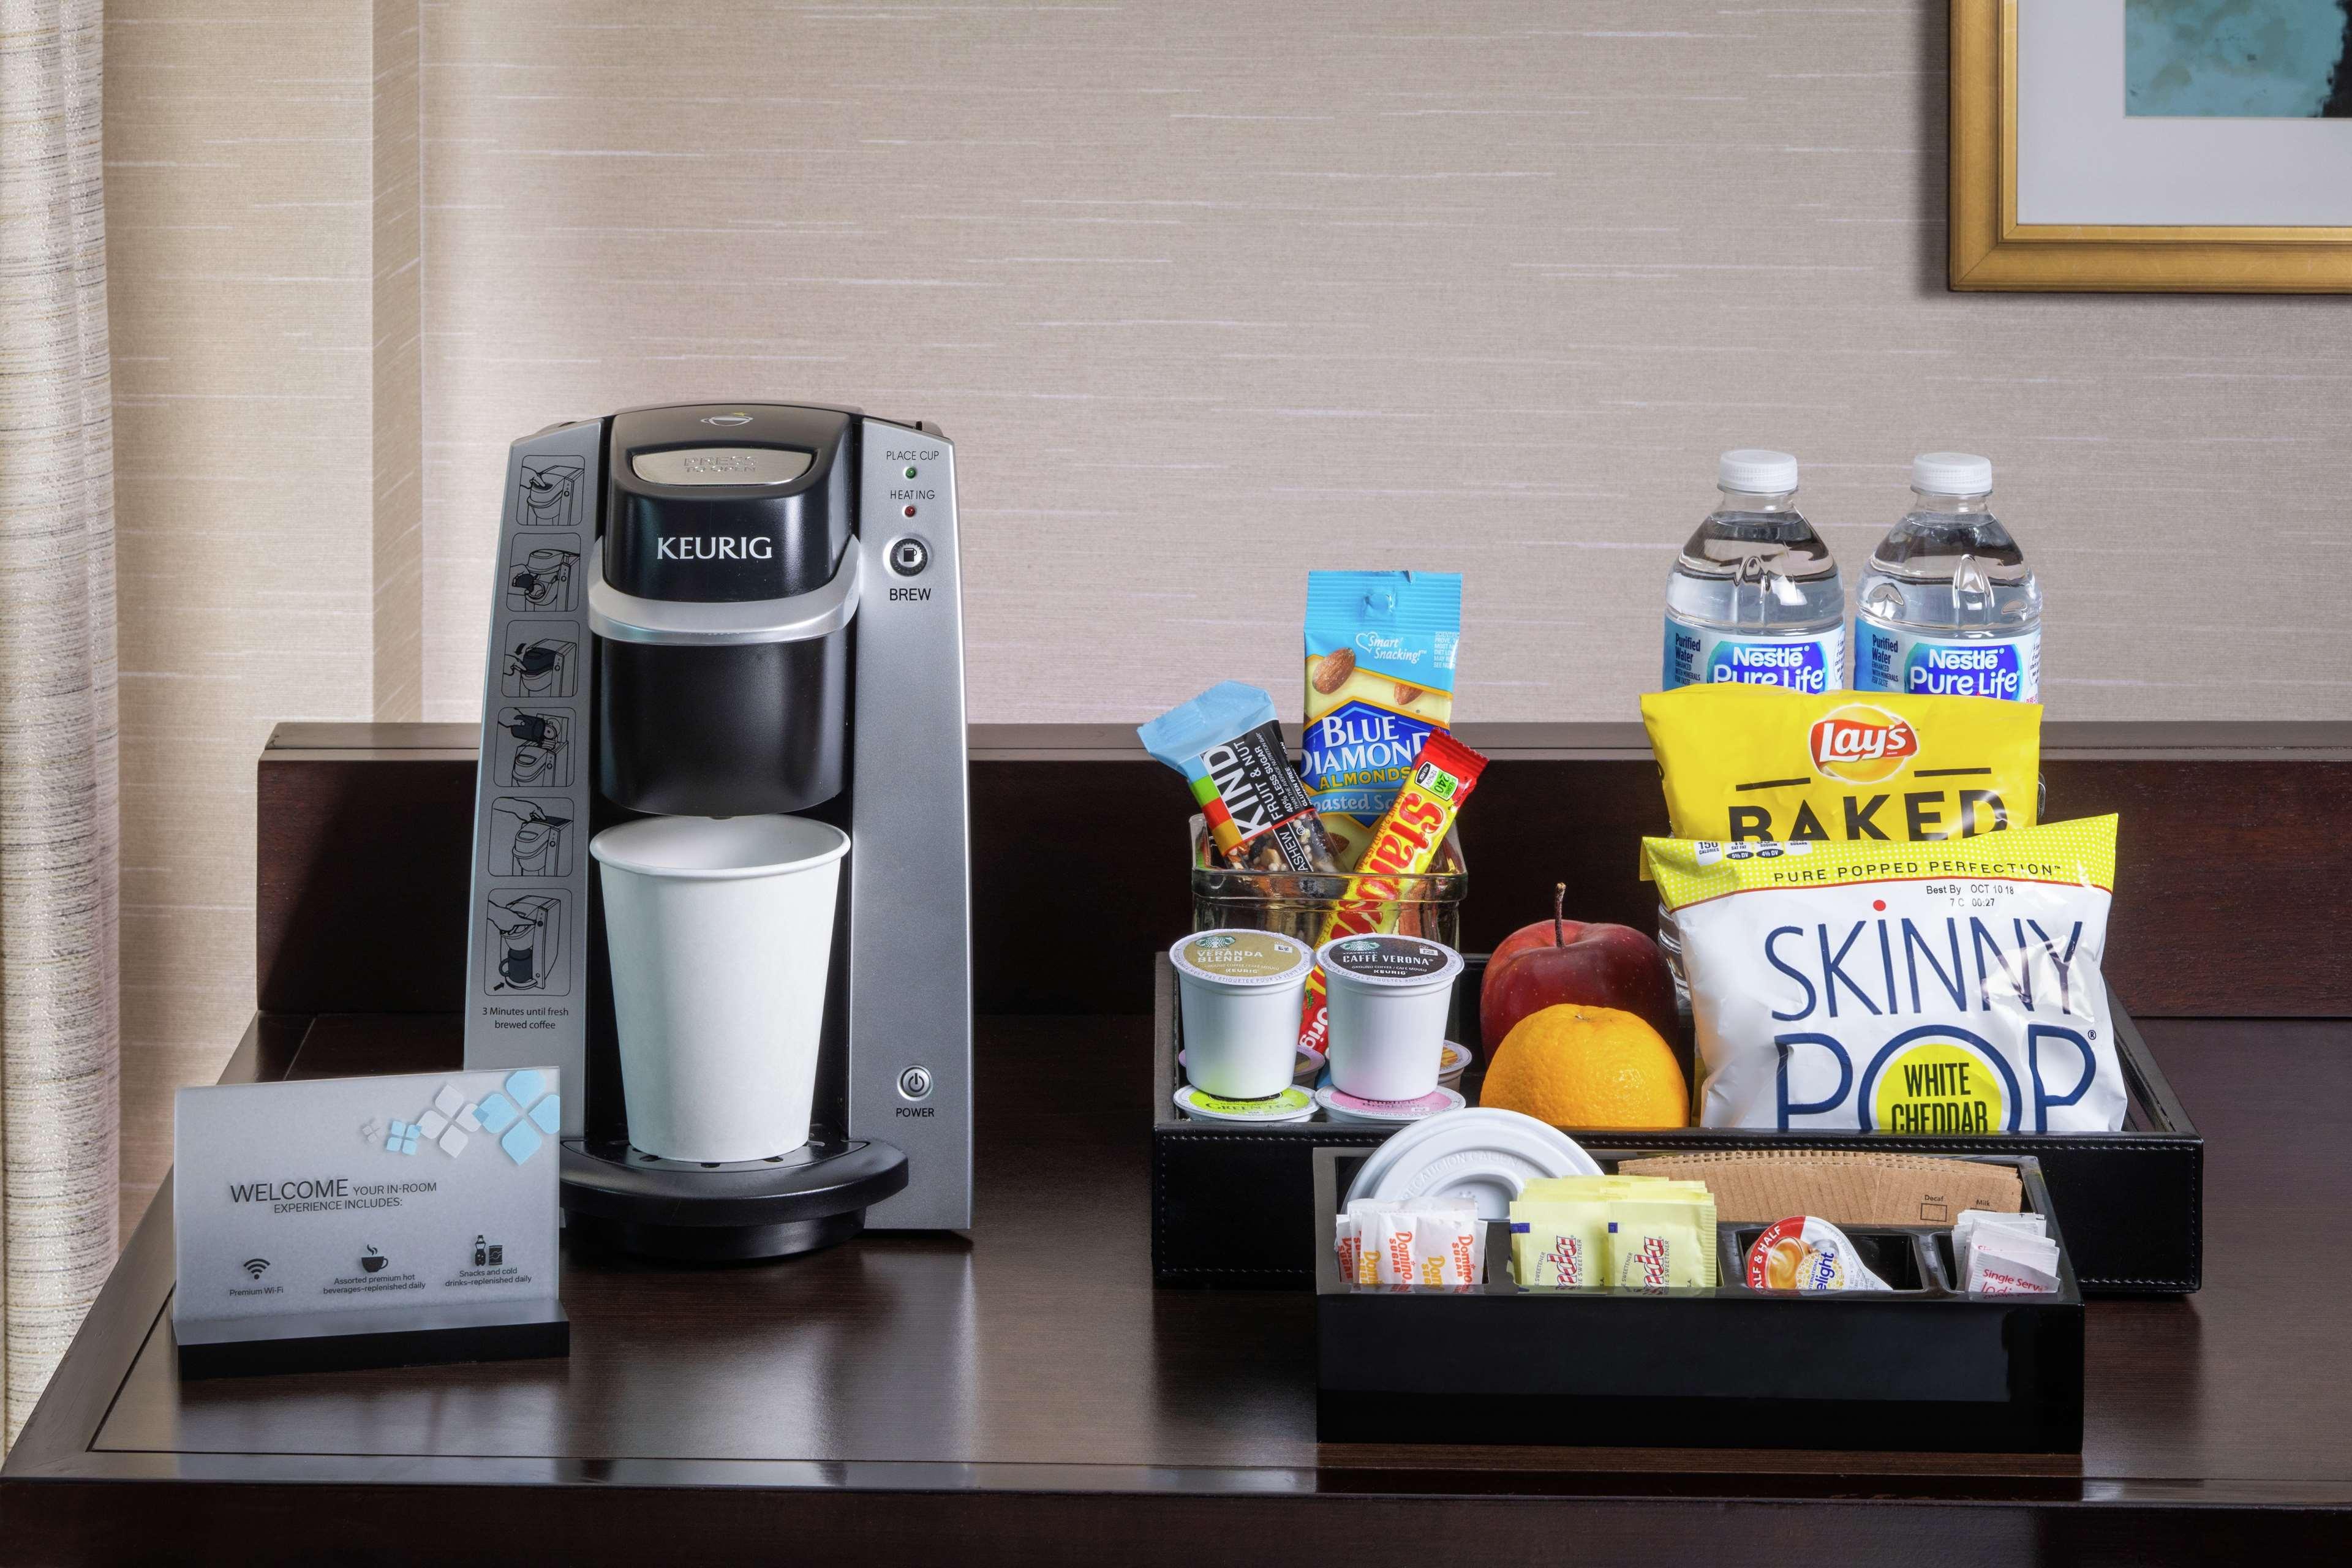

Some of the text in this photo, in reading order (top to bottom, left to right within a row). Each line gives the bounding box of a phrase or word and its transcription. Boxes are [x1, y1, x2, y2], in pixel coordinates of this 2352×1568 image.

[886, 451, 940, 460] PLACE CUP
[890, 490, 936, 500] HEATING
[657, 537, 773, 560] KEURIG
[889, 588, 932, 601] BREW
[1368, 636, 1400, 647] Smart
[1675, 633, 1701, 652] Purified
[1872, 634, 1899, 654] Purified
[1374, 648, 1422, 665] Snacking!
[1675, 648, 1694, 663] Water
[1872, 648, 1891, 663] Water
[1713, 664, 1825, 693] Pure Life
[1909, 666, 2018, 699] Pure Life
[1322, 715, 1400, 748] BLUE
[1819, 722, 1908, 763] Lay's
[1234, 741, 1284, 821] FRUIT & NUT
[1254, 745, 1294, 813] 40% LESS SUGAR
[1284, 766, 1296, 783] FREE
[1320, 766, 1412, 790] ALMONDS
[1434, 773, 1450, 794] 240
[1202, 745, 1272, 841] KIND
[1292, 782, 1308, 807] GLUTEN
[1727, 790, 2008, 842] BAKED
[1774, 869, 1827, 883] PURE
[1838, 862, 1918, 877] POPPED
[1926, 884, 2015, 897] Best By OCT 10 18
[1972, 898, 1995, 907] 00:27
[1382, 955, 1430, 965] VERONA
[481, 1007, 569, 1016] 3 Minutes until fresh
[494, 1020, 556, 1029] brewed coffee
[1903, 1062, 1972, 1098] WHITE
[895, 1107, 935, 1118] POWER
[230, 1178, 437, 1203] WELCOME YOUR IN-ROOM
[273, 1197, 403, 1214] EXPERIENCE INCLUDES:
[1757, 1225, 1781, 1253] HALF
[1389, 1238, 1401, 1273] SUGAR
[1395, 1231, 1413, 1281] Domino
[1452, 1242, 1463, 1278] SUGAR
[1458, 1234, 1474, 1283] Domino
[1754, 1255, 1763, 1264] &
[459, 1268, 486, 1278] Snacks
[501, 1267, 518, 1275] cold
[1535, 1251, 1546, 1283] SWEETENER
[1622, 1252, 1633, 1283] SWEETENER
[1983, 1268, 2015, 1284] Single
[334, 1276, 368, 1285] Assorted
[368, 1275, 401, 1284] premium
[408, 1281, 426, 1290] daily
[514, 1275, 532, 1284] daily
[229, 1286, 284, 1297] Premium Wi-Fi
